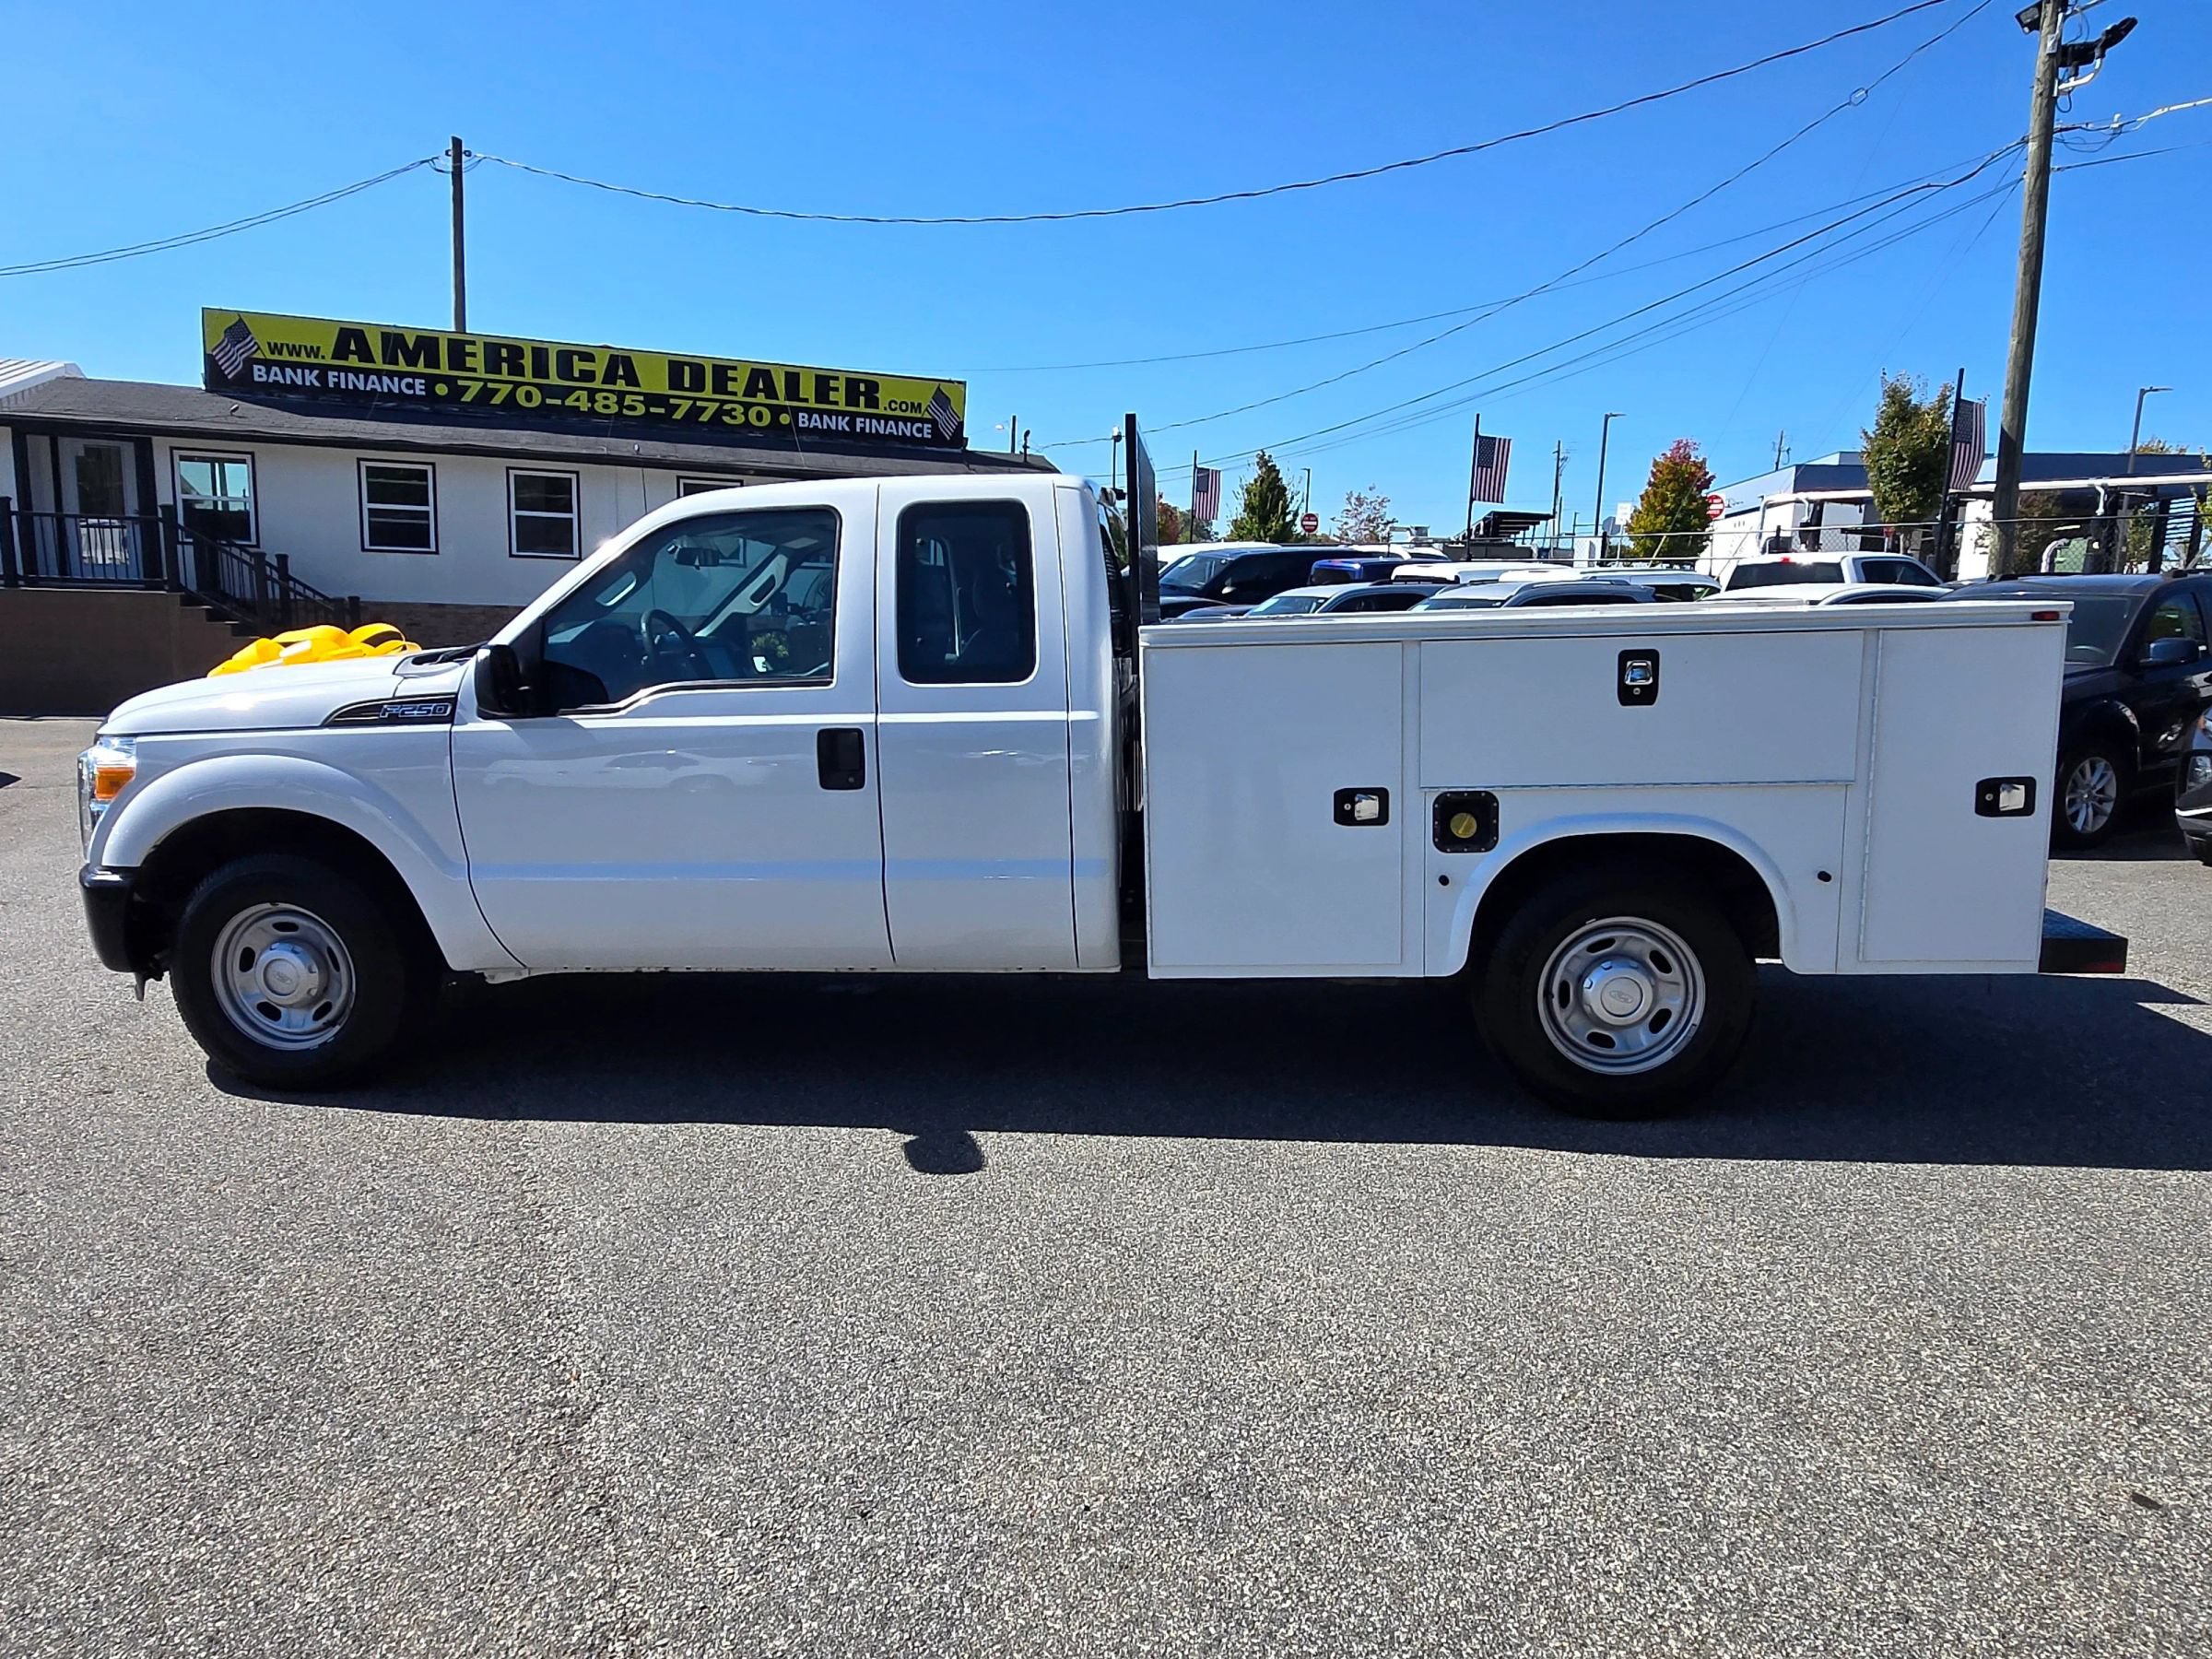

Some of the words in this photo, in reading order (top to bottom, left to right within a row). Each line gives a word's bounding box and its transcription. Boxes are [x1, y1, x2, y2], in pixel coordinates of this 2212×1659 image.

[253, 364, 321, 387] BANK
[328, 372, 426, 395] FINANCE
[457, 380, 771, 427] 770-485-7730
[798, 412, 850, 431] BANK
[855, 418, 933, 438] FINANCE
[331, 327, 641, 388] AMERICA
[667, 359, 880, 410] DEALER
